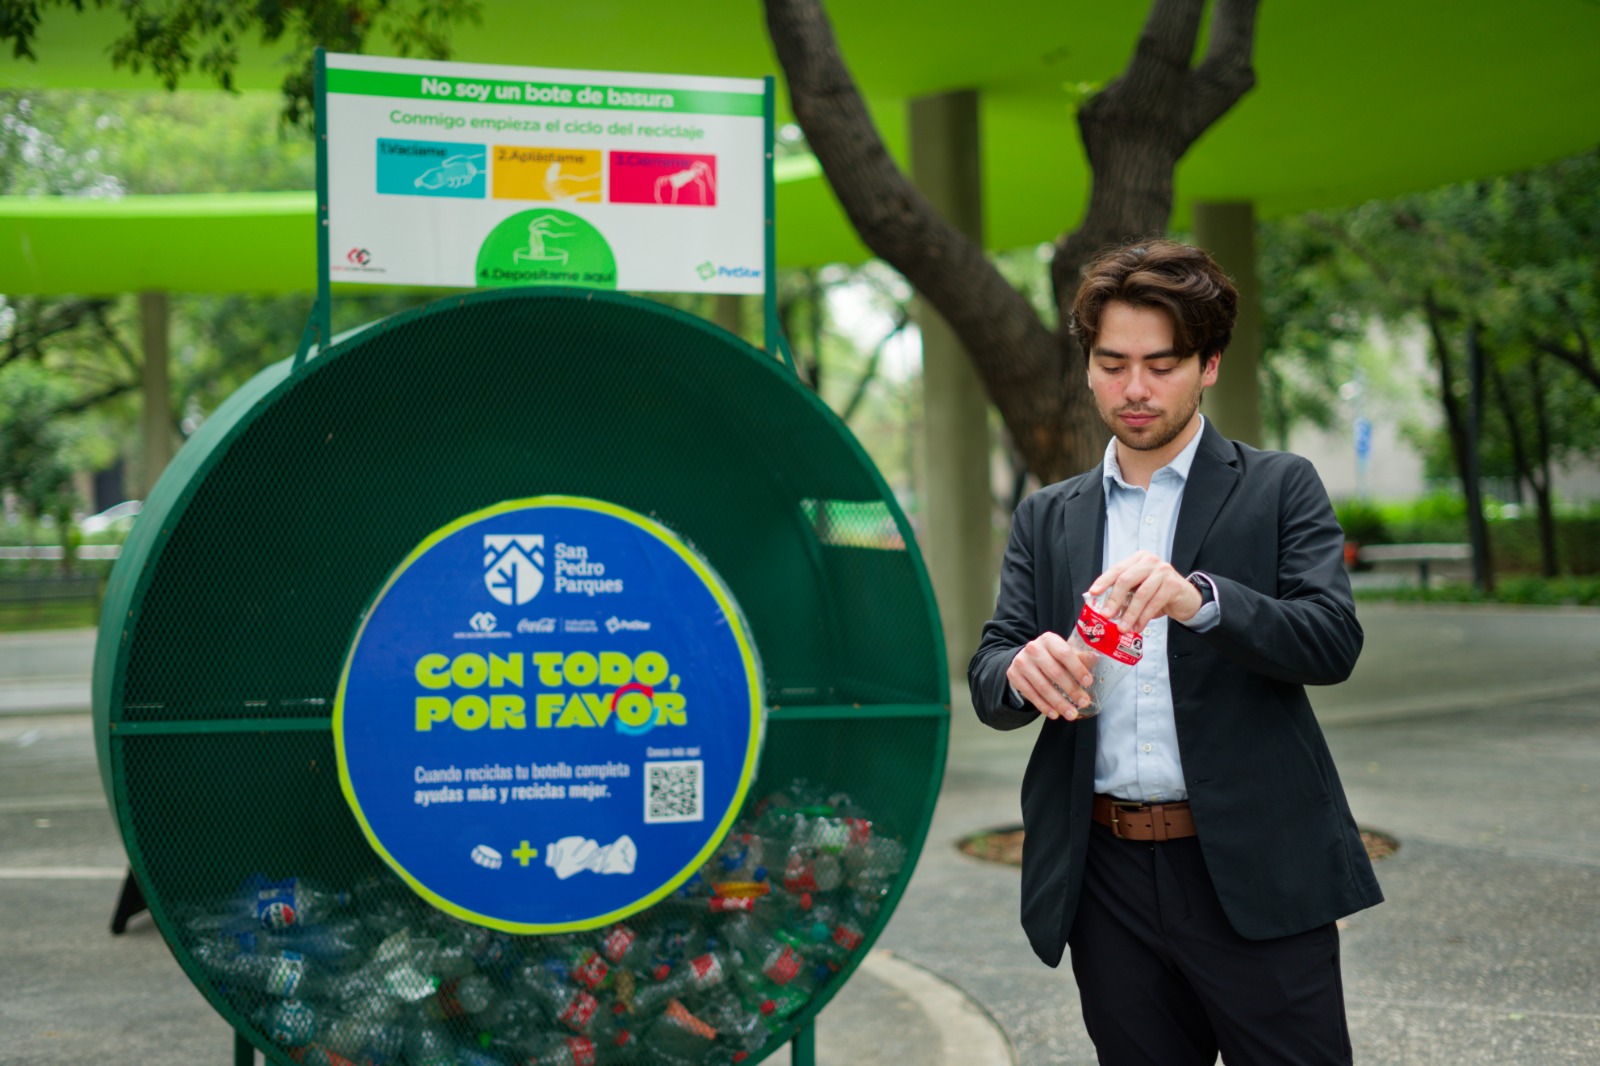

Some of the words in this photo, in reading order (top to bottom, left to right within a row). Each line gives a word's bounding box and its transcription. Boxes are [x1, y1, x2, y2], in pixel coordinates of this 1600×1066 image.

[421, 77, 450, 96] No
[455, 83, 491, 101] soy
[495, 85, 521, 100] un
[525, 84, 572, 103] bote
[576, 86, 603, 105] de
[607, 88, 674, 108] basura
[389, 110, 466, 129] Conmigo
[470, 114, 541, 131] empieza
[545, 119, 560, 133] el
[564, 121, 603, 135] ciclo
[607, 122, 633, 136] del
[638, 124, 704, 140] reciclaje
[554, 542, 588, 559] San
[554, 559, 605, 576] Pedro
[554, 576, 623, 596] Parques
[415, 652, 524, 689] CON
[533, 651, 681, 691] TODO,
[415, 694, 526, 731] POR
[536, 692, 687, 727] FAVOR
[415, 766, 462, 784] Cuando
[465, 763, 513, 782] reciclas
[516, 763, 529, 780] tu
[532, 761, 573, 779] botella
[575, 761, 630, 780] completa
[414, 785, 463, 807] ayudas
[467, 784, 497, 802] más
[500, 788, 508, 804] y
[512, 782, 565, 800] reciclas
[569, 781, 611, 801] mejor.
